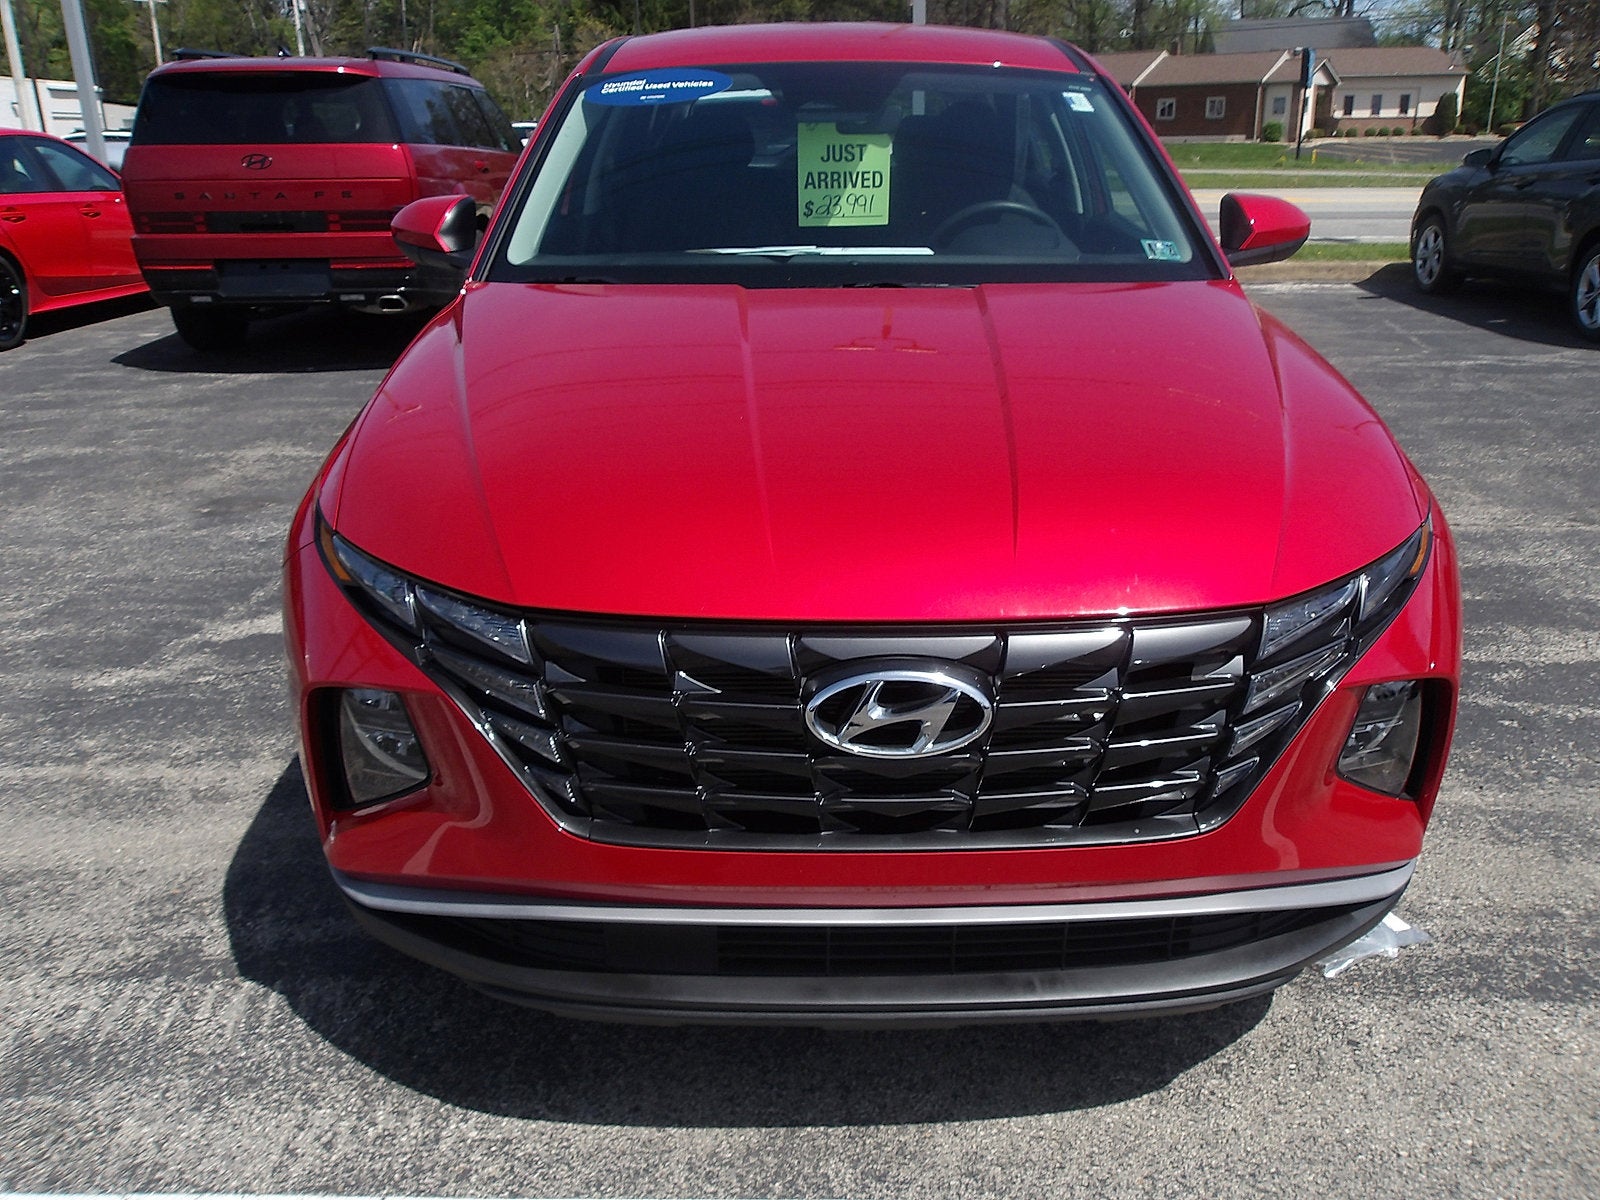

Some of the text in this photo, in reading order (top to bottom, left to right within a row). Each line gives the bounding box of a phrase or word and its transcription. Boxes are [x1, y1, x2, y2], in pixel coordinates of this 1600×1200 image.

[603, 79, 646, 89] Hyundai
[645, 82, 671, 90] Used
[672, 80, 714, 88] Vehicles
[821, 144, 867, 162] JUST
[804, 171, 883, 189] ARRIVED
[174, 190, 353, 200] SANTA FE
